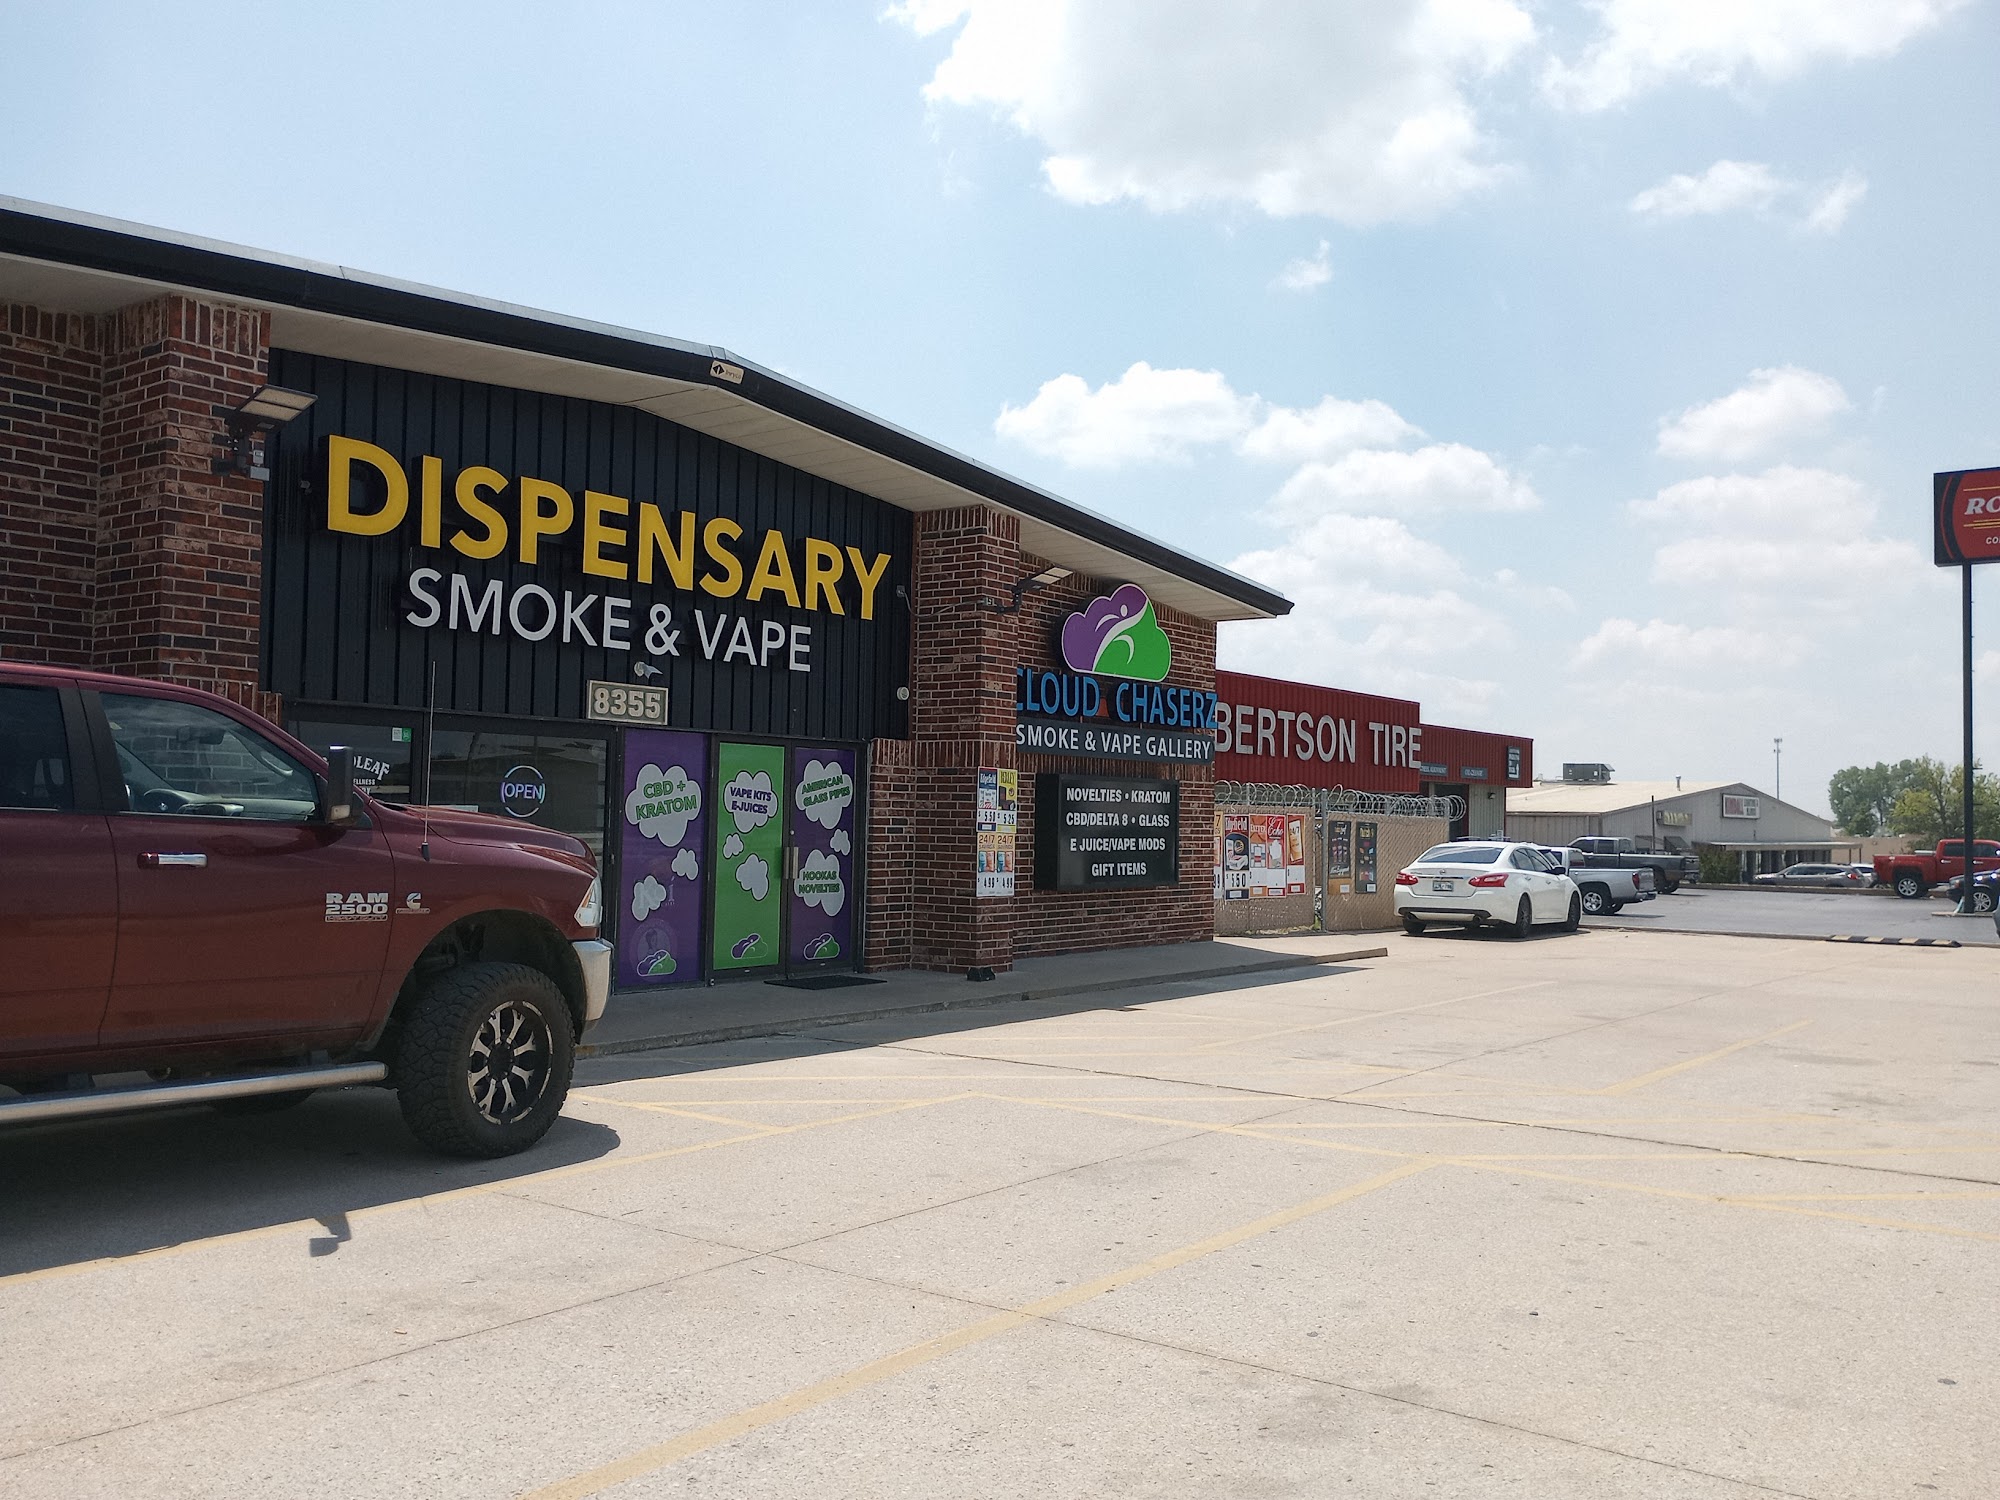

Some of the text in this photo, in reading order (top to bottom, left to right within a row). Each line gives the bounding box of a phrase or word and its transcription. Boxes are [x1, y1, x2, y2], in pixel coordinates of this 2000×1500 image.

[327, 434, 891, 621] DISPENSARY
[406, 567, 812, 673] SMOKE & VAPE
[594, 687, 661, 719] 8355
[1116, 682, 1218, 729] CHASERZ
[1016, 723, 1211, 760] SMOKE & VAPE GALLERY
[1215, 701, 1422, 769] BERTSON TIRE
[504, 783, 542, 799] OPEN
[643, 780, 686, 799] CBD +
[802, 775, 844, 795] AMERICAN
[730, 786, 772, 802] VAPE KITS
[803, 786, 850, 807] GLASS PIPES
[1066, 787, 1171, 804] NOVELTIES KRATOM
[635, 795, 698, 820] KRATOM
[731, 801, 768, 815] E-JUICES
[1066, 812, 1170, 827] CBD/DELTA 8 GLASS
[1070, 838, 1166, 852] E JUICE/VAPE MODS
[802, 870, 837, 881] HOOKAS
[1091, 862, 1147, 877] GIFT ITEMS
[798, 883, 840, 894] NOVELTIES
[326, 892, 389, 904] RAM
[325, 904, 388, 915] 2500
